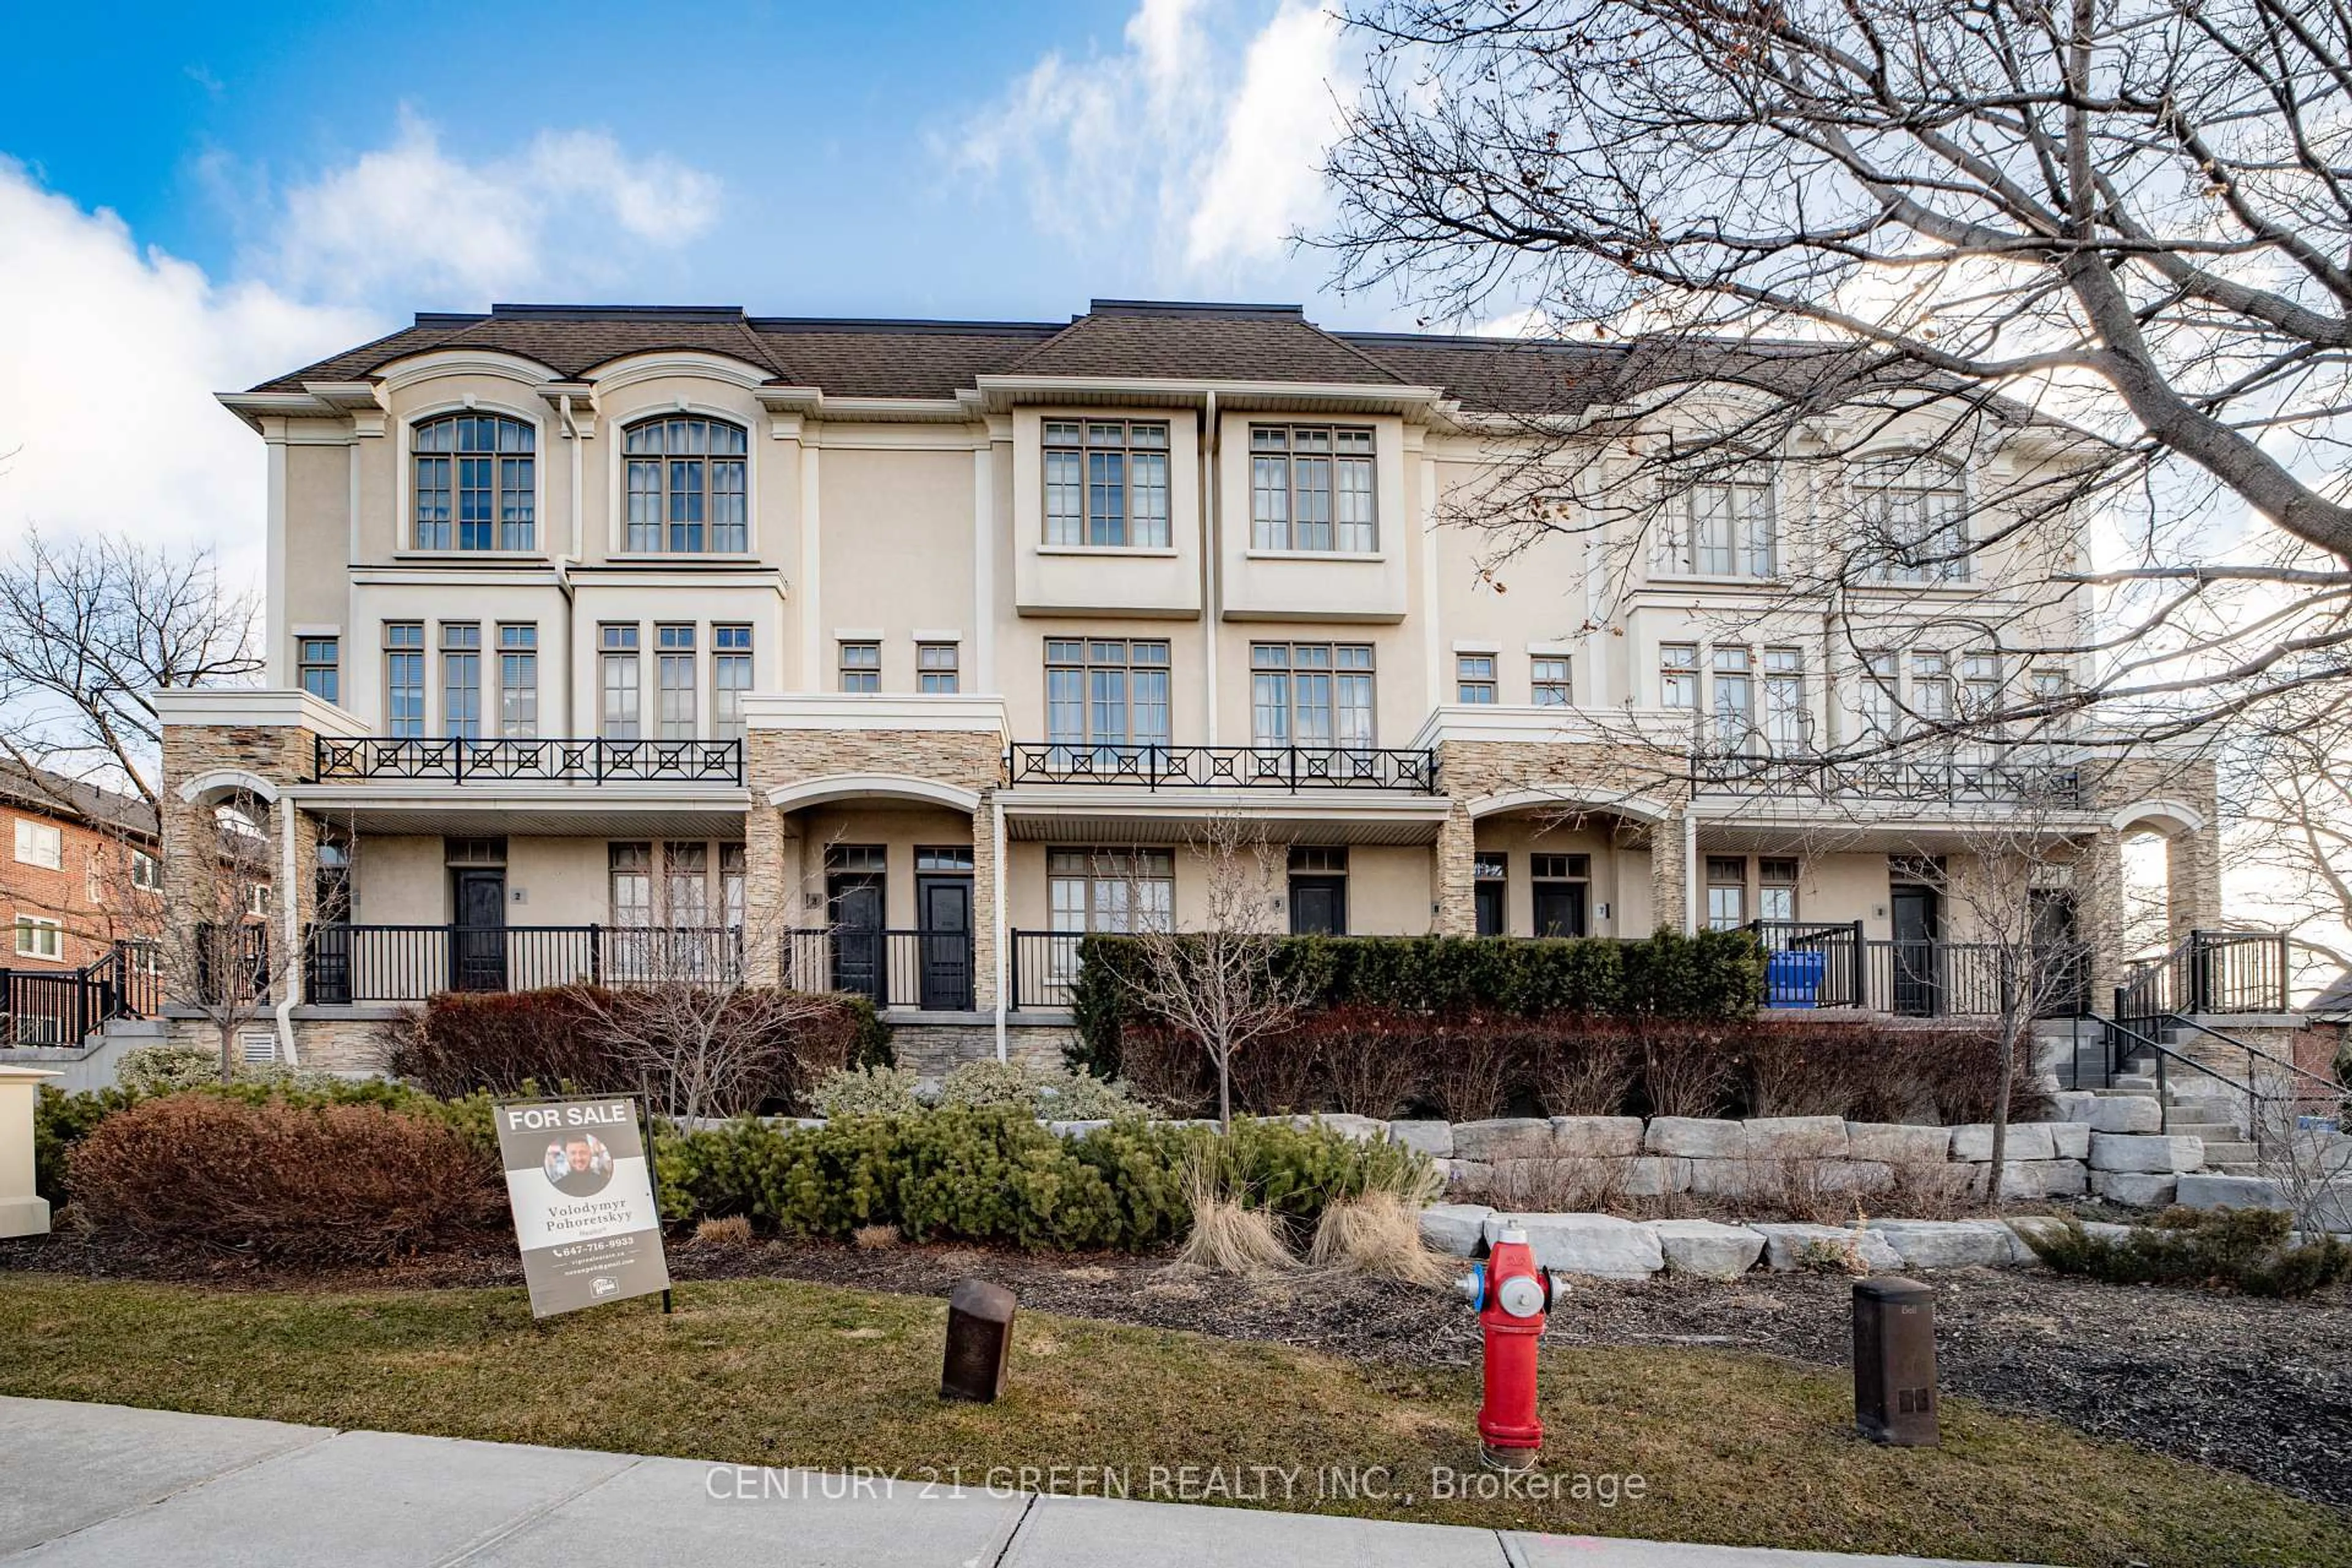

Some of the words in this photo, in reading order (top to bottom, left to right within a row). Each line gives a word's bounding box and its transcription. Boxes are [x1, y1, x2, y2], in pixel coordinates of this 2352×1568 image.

[508, 1109, 562, 1130] FOR
[567, 1104, 627, 1126] SALE
[548, 1199, 626, 1217] Volodymyr
[546, 1211, 632, 1231] Pohoretskyy
